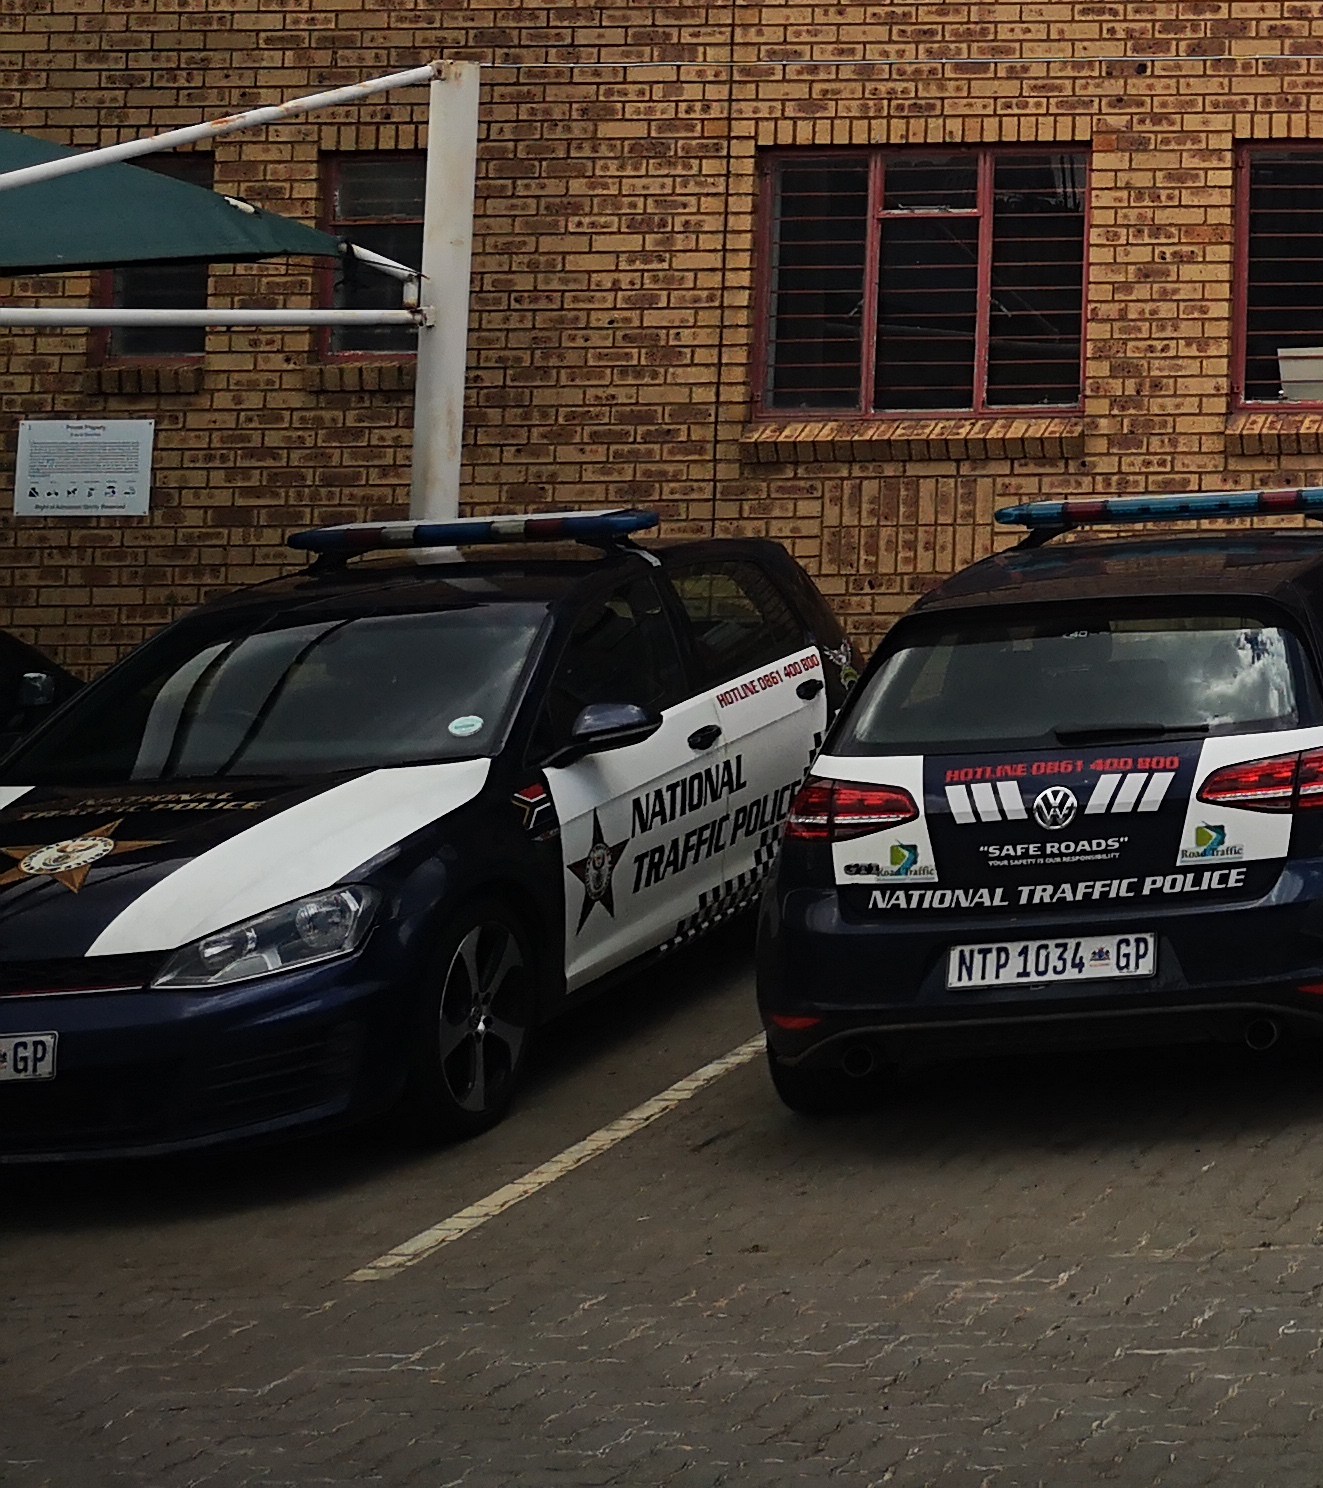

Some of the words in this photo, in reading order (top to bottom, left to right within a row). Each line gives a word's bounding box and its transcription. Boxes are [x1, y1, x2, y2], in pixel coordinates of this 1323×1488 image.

[716, 679, 759, 708] HOTLINE
[757, 669, 784, 691] 0861
[783, 661, 803, 679] 400
[945, 764, 1028, 782] HOTLINE
[1032, 760, 1084, 775] 0861
[1089, 758, 1133, 772] 400
[1137, 755, 1180, 770] 800
[150, 800, 267, 811] POLICE
[630, 754, 747, 839] NATIONAL
[632, 813, 731, 894] TRAFFIC
[988, 859, 1009, 867] YOUR
[1010, 858, 1036, 866] SAFETY
[1062, 852, 1121, 863] RESPONSIBILITY
[868, 888, 1010, 909] NATIONAL
[1017, 877, 1138, 906] TRAFFIC
[1141, 867, 1247, 896] POLICE
[957, 945, 1011, 982] NTP
[1016, 941, 1086, 979] 1034
[1116, 937, 1149, 971] GP
[13, 1040, 47, 1074] GP
